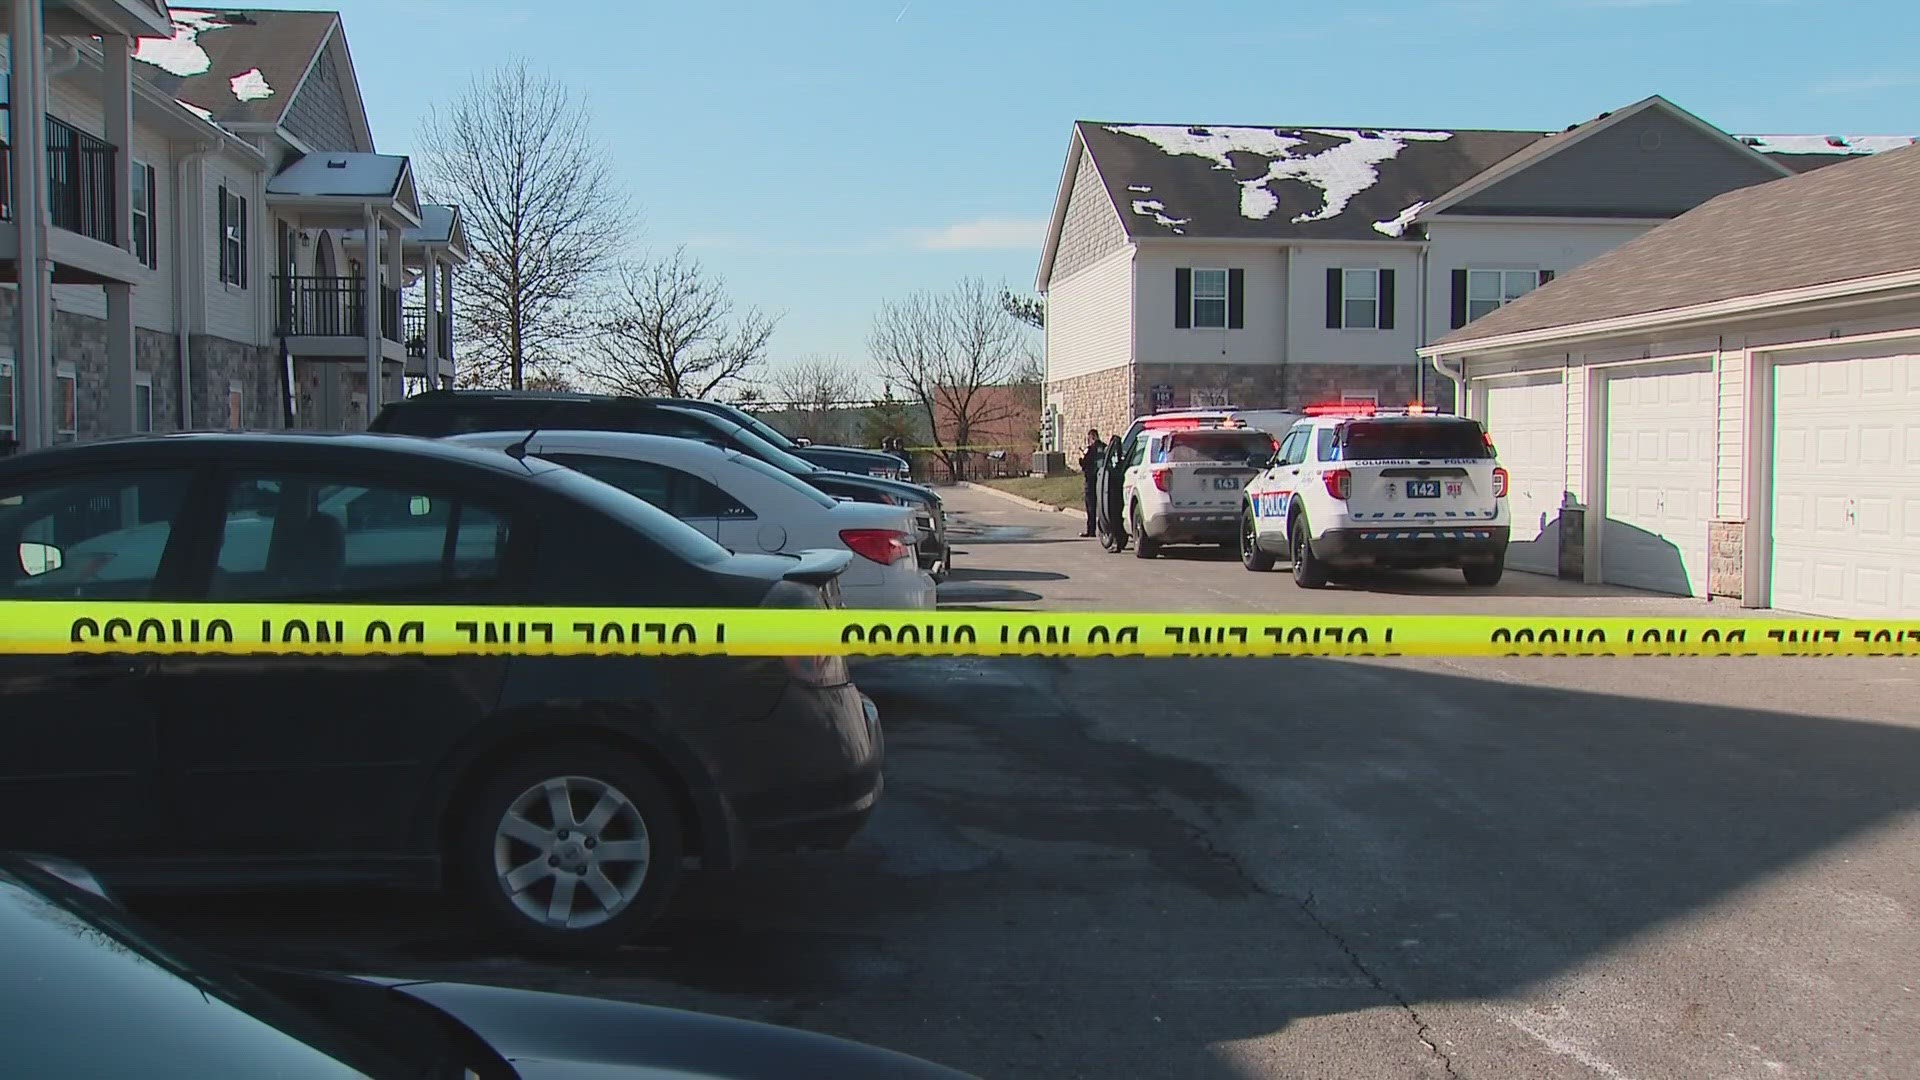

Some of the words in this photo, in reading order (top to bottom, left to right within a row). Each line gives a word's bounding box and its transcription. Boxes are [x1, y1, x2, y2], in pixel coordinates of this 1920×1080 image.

[1217, 479, 1235, 489] 143
[1412, 483, 1435, 496] 142
[1264, 493, 1287, 516] POLICE
